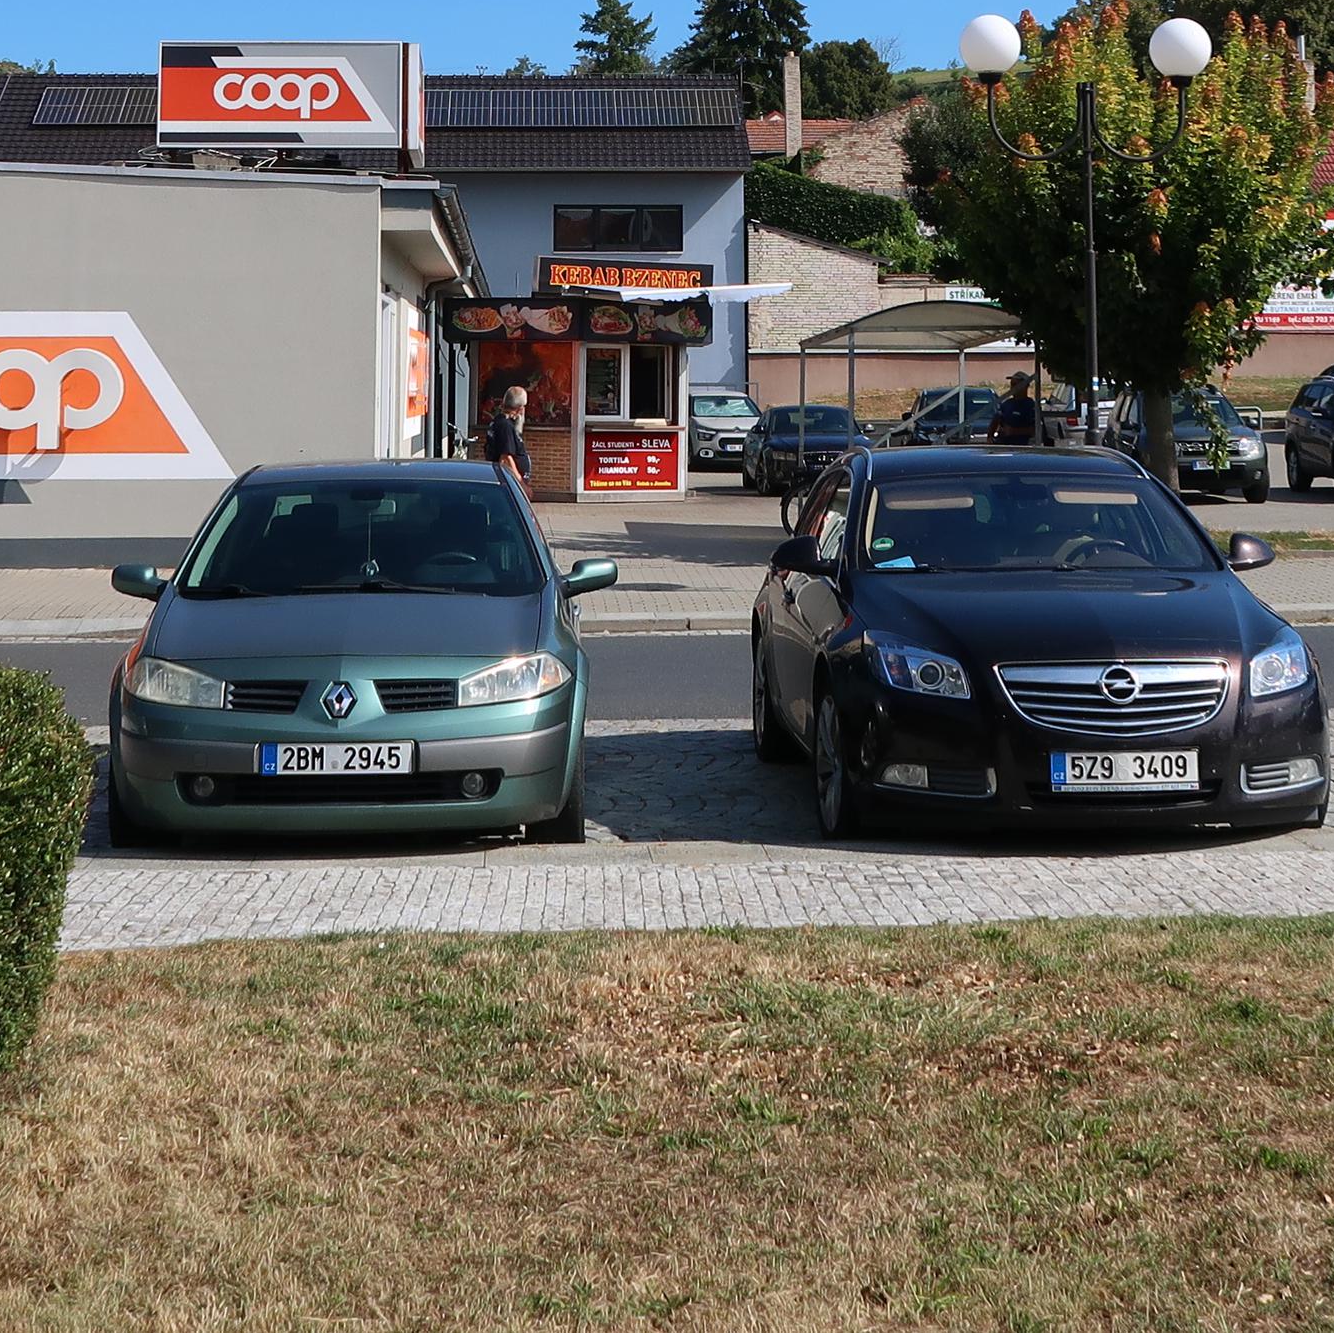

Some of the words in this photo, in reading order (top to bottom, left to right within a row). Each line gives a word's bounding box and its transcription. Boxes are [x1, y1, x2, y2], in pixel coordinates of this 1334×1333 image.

[213, 73, 339, 119] coop
[550, 265, 619, 286] KEBAB
[622, 268, 701, 289] BZENEC
[641, 439, 671, 448] SLEVA
[599, 456, 630, 464] TORTILA
[282, 746, 325, 771] 2BM
[343, 746, 401, 770] 2945
[1053, 772, 1065, 780] CZ
[1071, 756, 1114, 779] 5Z9
[1133, 755, 1187, 779] 3409
